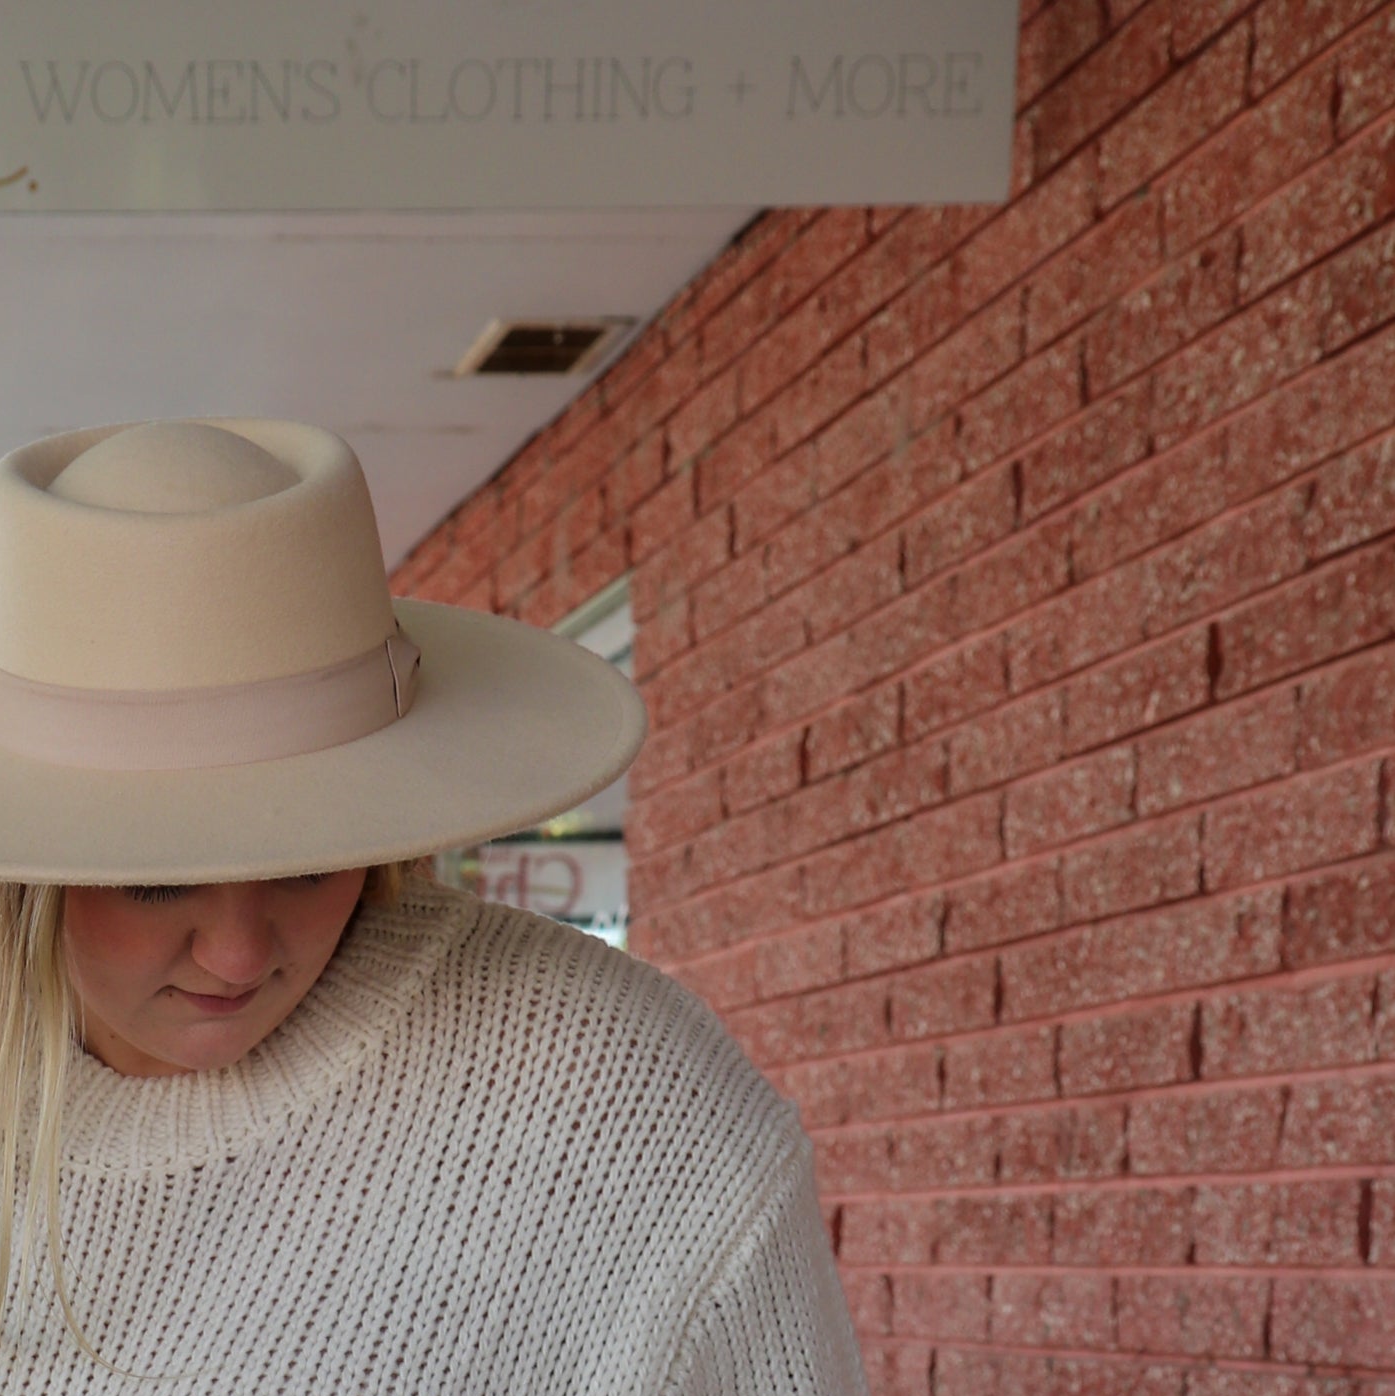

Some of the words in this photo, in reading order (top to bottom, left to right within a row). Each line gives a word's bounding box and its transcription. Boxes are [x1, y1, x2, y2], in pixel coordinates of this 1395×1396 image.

[18, 59, 342, 126] WOMEN'S
[365, 56, 695, 125] CLOTHING
[785, 52, 983, 121] MORE
